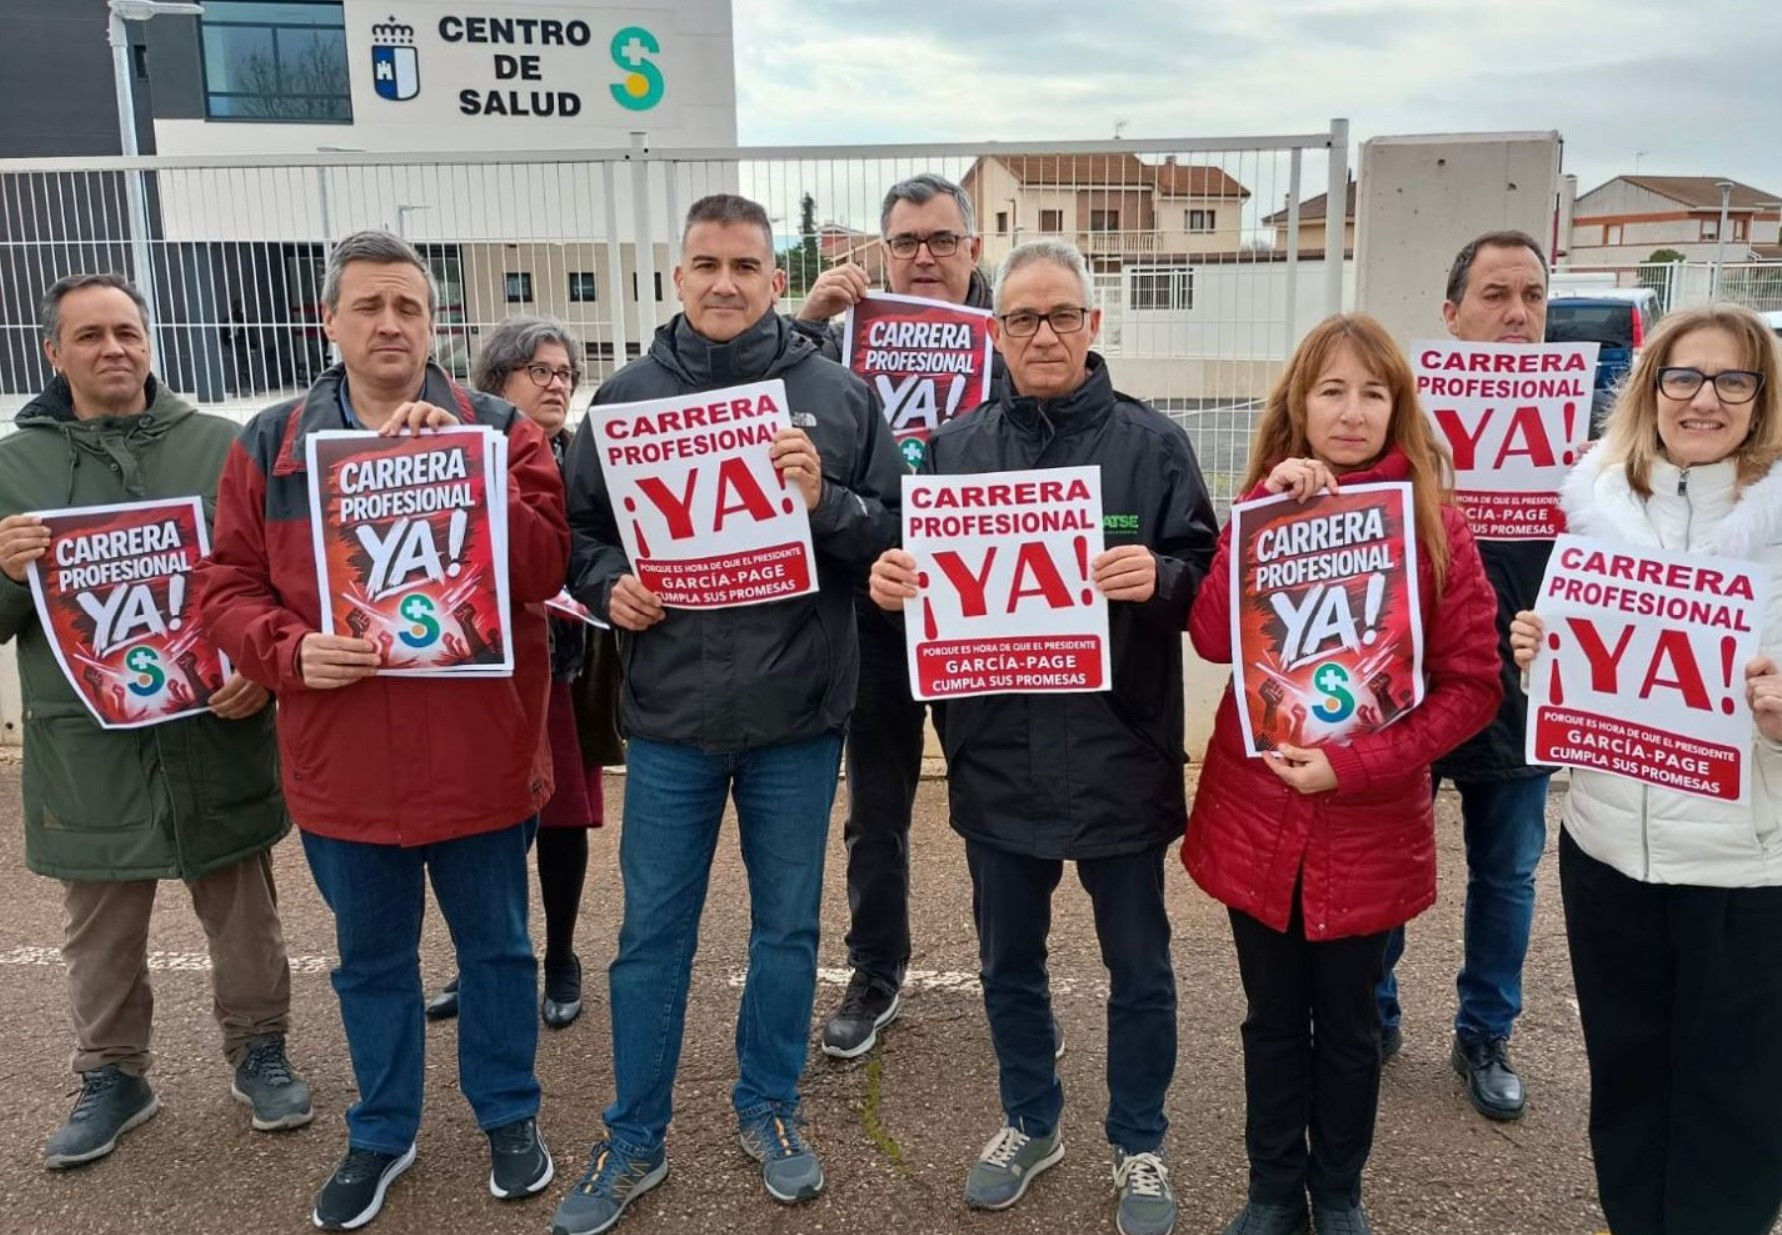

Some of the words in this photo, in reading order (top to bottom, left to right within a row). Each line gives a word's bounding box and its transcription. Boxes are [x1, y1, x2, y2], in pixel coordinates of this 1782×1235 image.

[438, 16, 591, 46] CENTRO
[494, 55, 542, 80] DE
[459, 89, 582, 117] SALUD
[869, 321, 971, 349] CARRERA
[865, 350, 974, 373] PROFESIONAL
[1421, 350, 1586, 373] CARRERA
[1417, 376, 1585, 398] PROFESIONAL
[605, 395, 779, 440] CARRERA
[1433, 401, 1576, 471] YA!
[340, 449, 466, 495] CARRERA
[340, 483, 475, 523] PROFESIONAL
[911, 479, 1091, 509] CARRERA
[1480, 496, 1491, 504] DE
[1493, 496, 1510, 505] QUE
[910, 509, 1094, 537] PROFESIONAL
[1103, 515, 1139, 528] ATSE
[1464, 505, 1548, 520] CÍA-PAGE
[56, 520, 181, 567] CARRERA
[1257, 508, 1384, 563] CARRERA
[1470, 524, 1488, 534] US
[1490, 524, 1555, 535] PROMESAS
[355, 508, 468, 601] YA!
[640, 563, 672, 574] PORQUE
[674, 565, 683, 573] ES
[685, 563, 709, 573] HORA
[710, 561, 722, 570] DE
[723, 558, 740, 569] QUE
[742, 556, 752, 566] EL
[753, 546, 802, 563] PRESIDENTE
[1256, 544, 1394, 592] PROFESIONAL
[59, 551, 192, 592] PROFESIONAL
[662, 563, 785, 589] GARCÍA-PAGE
[1560, 547, 1755, 601] CARRERA
[703, 590, 727, 603] SUS
[729, 579, 796, 600] PROMESAS
[918, 535, 1093, 640] ¡YA!
[76, 574, 185, 657] YA!
[1548, 576, 1751, 632] PROFESIONAL
[1270, 572, 1386, 672] YA!
[923, 646, 959, 657] PORQUE
[961, 646, 971, 655] ES
[973, 644, 998, 655] HORA
[1000, 643, 1011, 653] DE
[1013, 642, 1031, 652] QUE
[1033, 641, 1043, 651] EL
[1044, 640, 1096, 651] PRESIDENTE
[945, 654, 1076, 674] GARCÍA-PAGE
[1548, 616, 1737, 716] ¡YA!
[932, 677, 986, 692] CUMPLA
[989, 675, 1014, 687] SUS
[1016, 673, 1086, 687] PROMESAS
[1544, 712, 1585, 726] PORQUE
[1586, 719, 1597, 728] ES
[1599, 722, 1625, 736] HORA
[1627, 728, 1640, 739] DE
[1641, 732, 1662, 745] QUE
[1663, 738, 1673, 749] EL
[1675, 740, 1736, 762] PRESIDENTE
[1567, 729, 1710, 775] GARCÍA-PAGE
[1550, 746, 1609, 766] CUMPLA
[1612, 757, 1639, 774] SUS
[1641, 765, 1720, 793] PROMESAS
